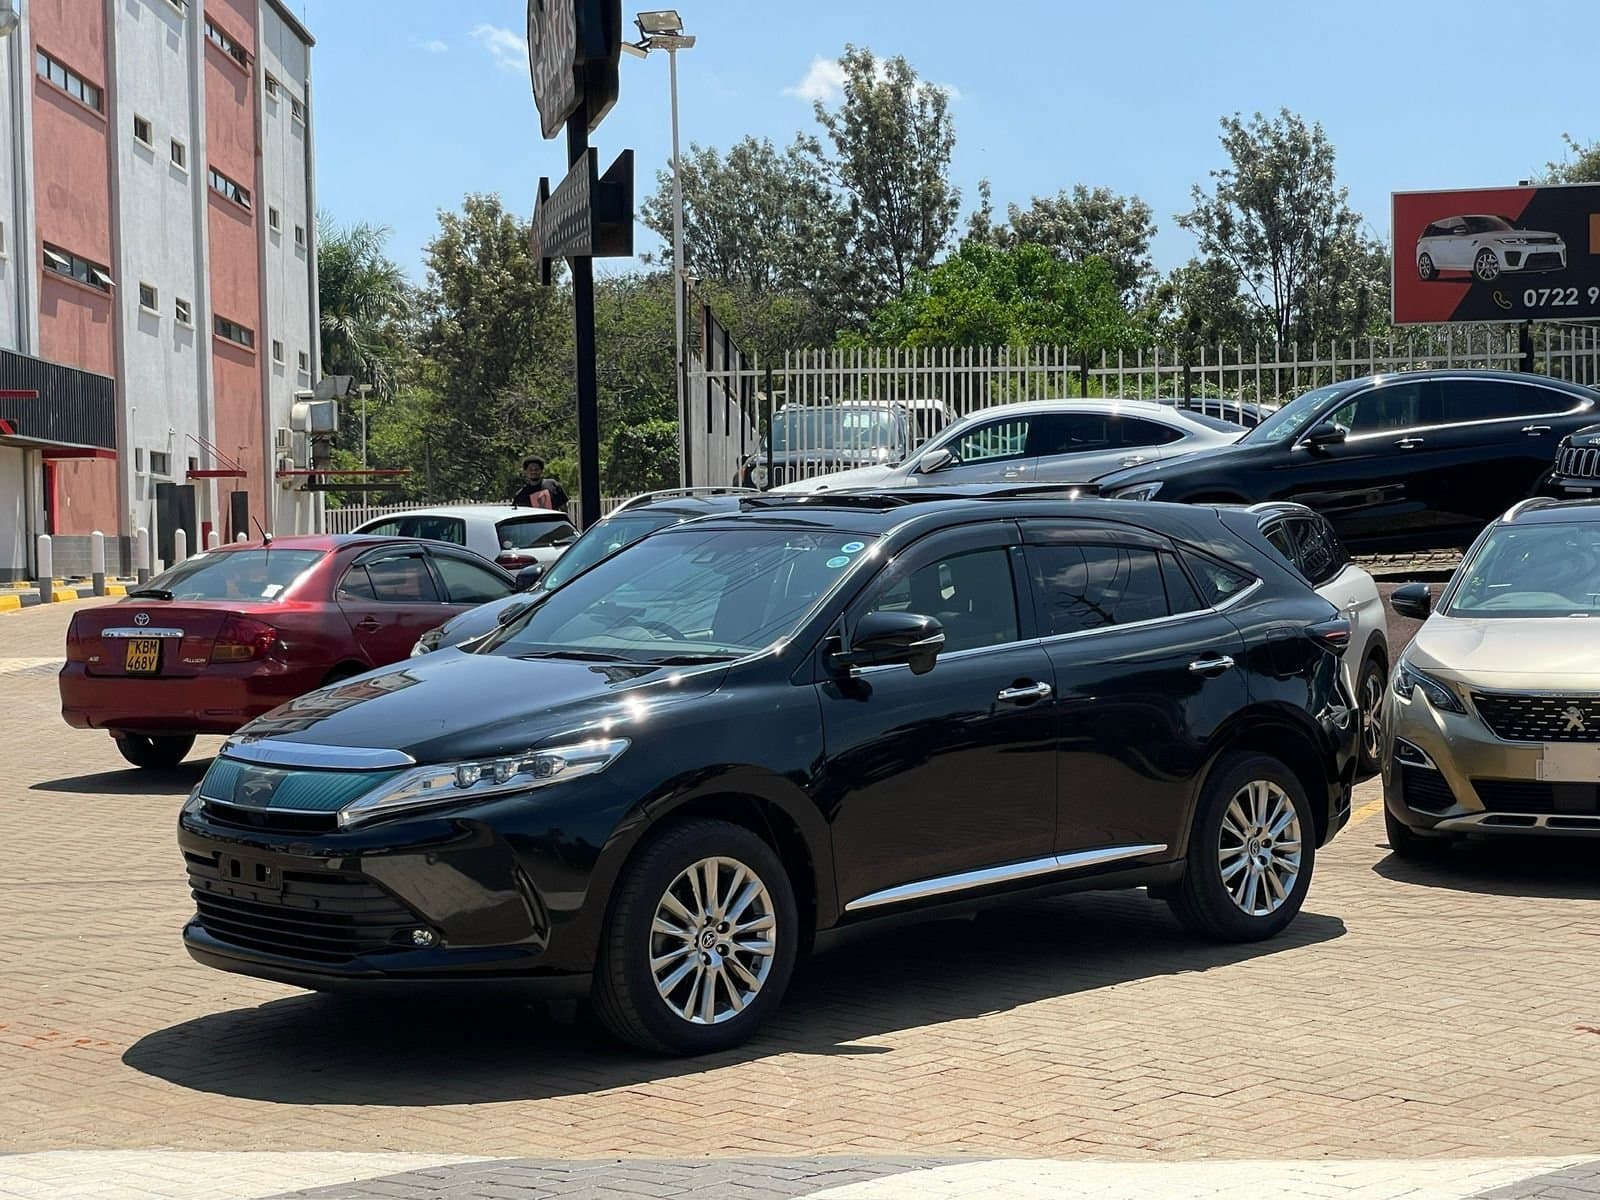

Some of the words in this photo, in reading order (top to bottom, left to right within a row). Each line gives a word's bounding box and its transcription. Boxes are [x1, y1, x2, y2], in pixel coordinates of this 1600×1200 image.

[1524, 288, 1578, 307] 0722
[1587, 286, 1600, 305] 9
[135, 640, 157, 654] KBM
[127, 656, 155, 670] 468Y
